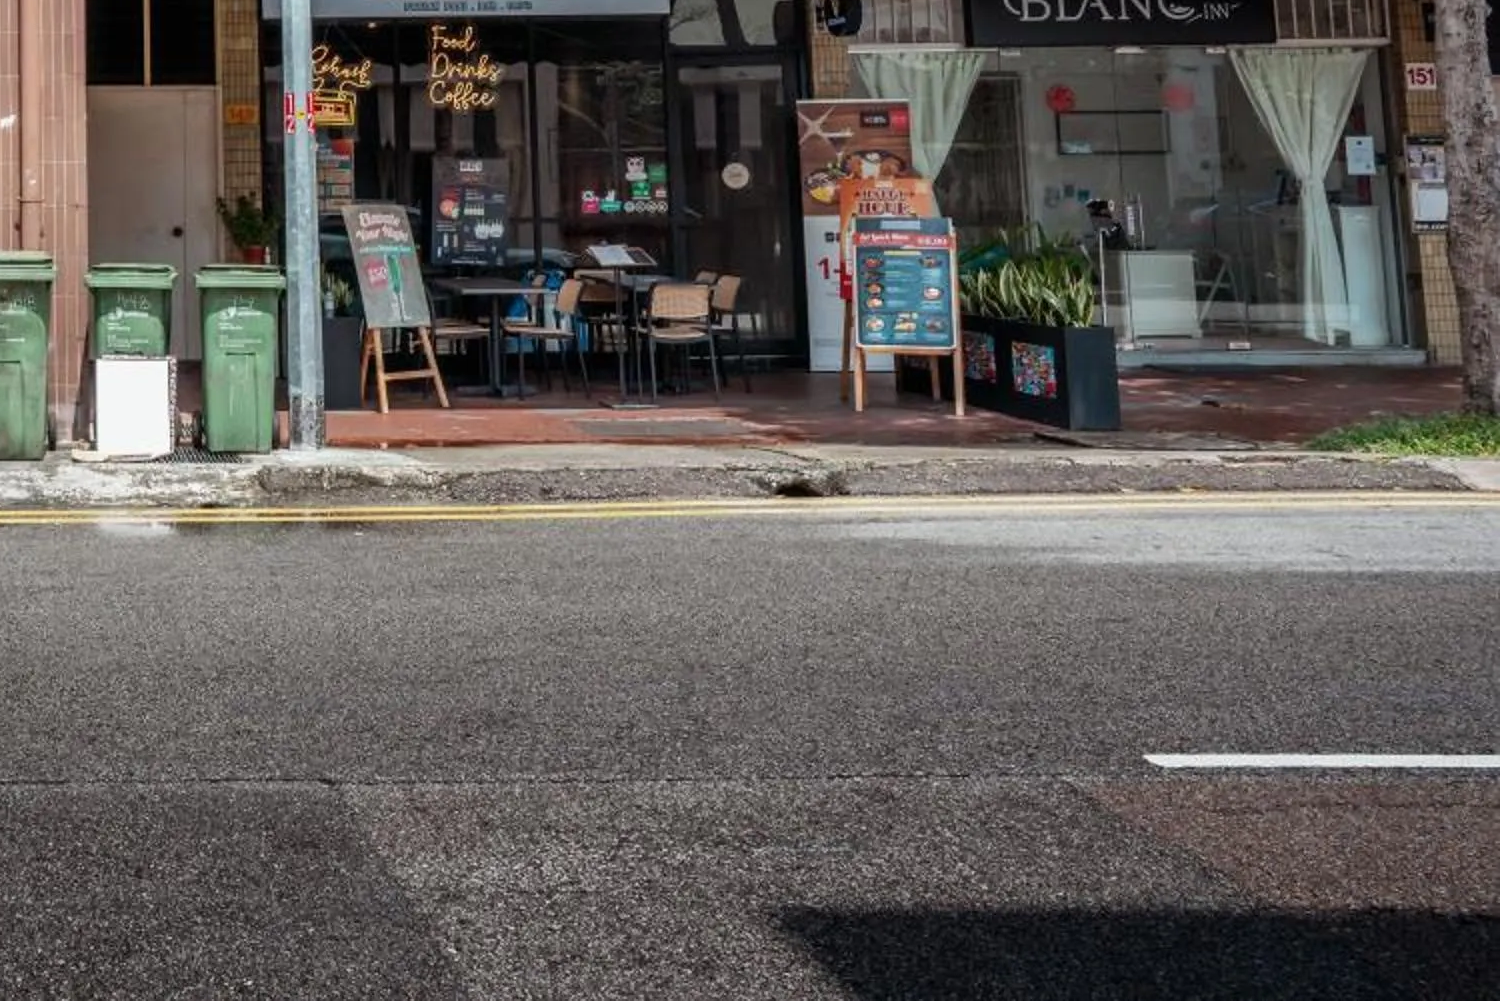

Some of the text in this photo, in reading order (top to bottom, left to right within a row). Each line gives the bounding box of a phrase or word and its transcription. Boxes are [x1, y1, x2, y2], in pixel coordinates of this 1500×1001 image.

[431, 26, 475, 52] Food
[431, 52, 501, 82] Drinks
[1407, 67, 1436, 86] 151
[429, 80, 496, 110] Coffee
